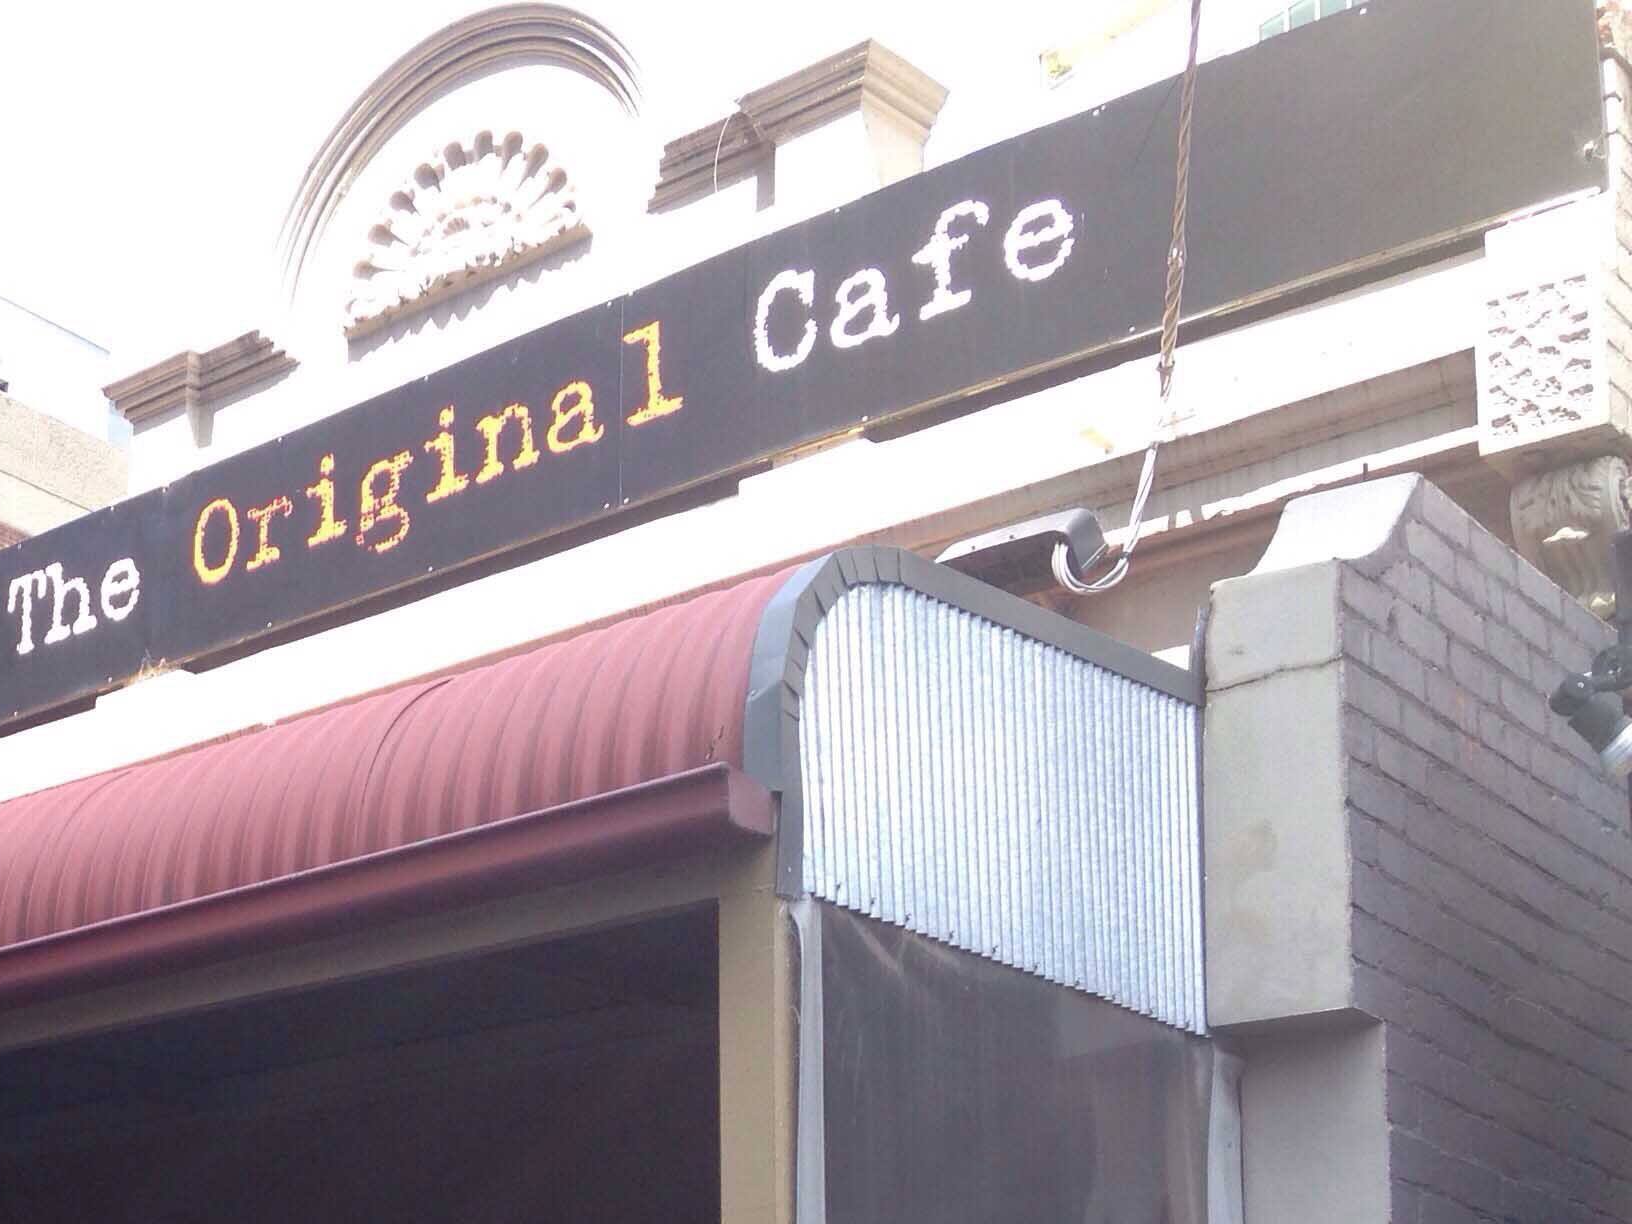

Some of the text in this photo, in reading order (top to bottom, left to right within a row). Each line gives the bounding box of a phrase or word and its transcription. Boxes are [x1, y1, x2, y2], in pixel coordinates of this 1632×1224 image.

[6, 191, 1078, 657] The Original Cafe
